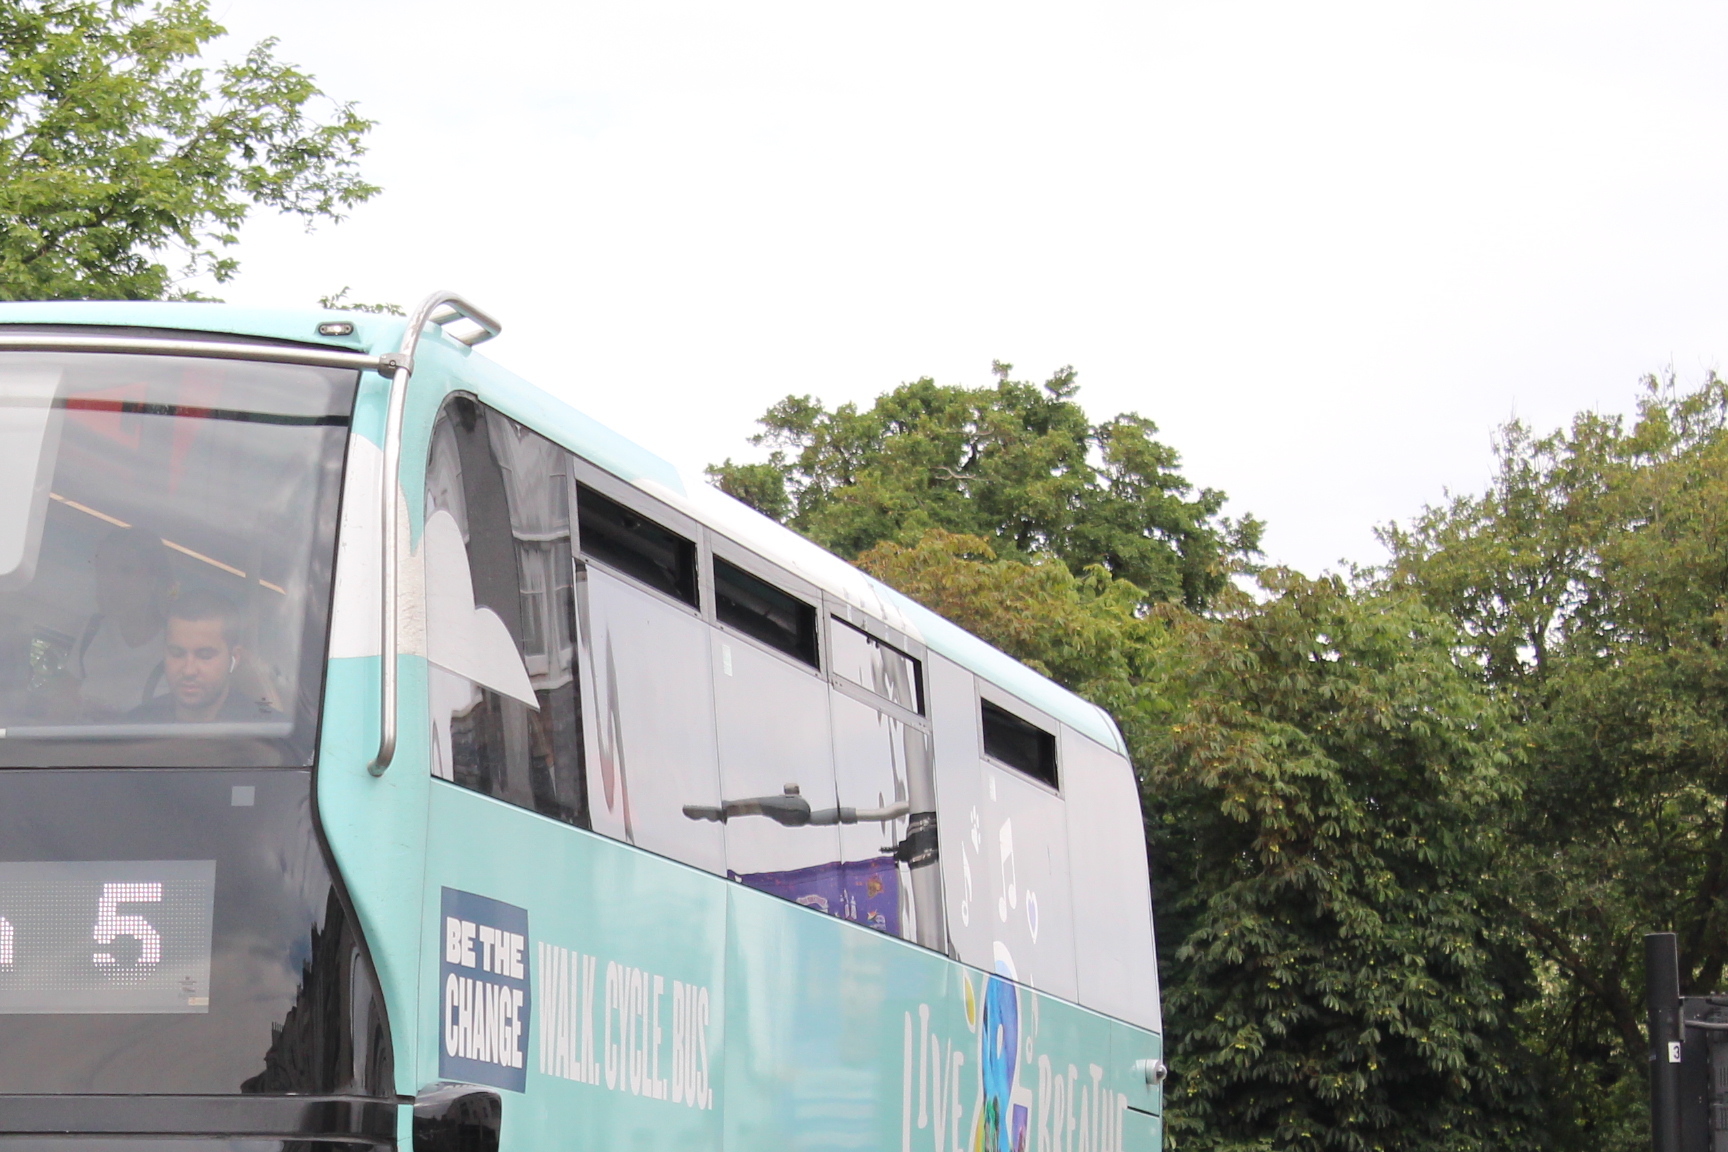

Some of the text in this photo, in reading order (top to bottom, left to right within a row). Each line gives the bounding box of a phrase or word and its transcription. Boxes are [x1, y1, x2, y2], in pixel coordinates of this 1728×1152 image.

[91, 881, 164, 986] 5
[445, 915, 524, 980] BE THE
[445, 972, 524, 1069] CHANGE
[538, 941, 713, 1111] WALK. CYCLE. BUS.
